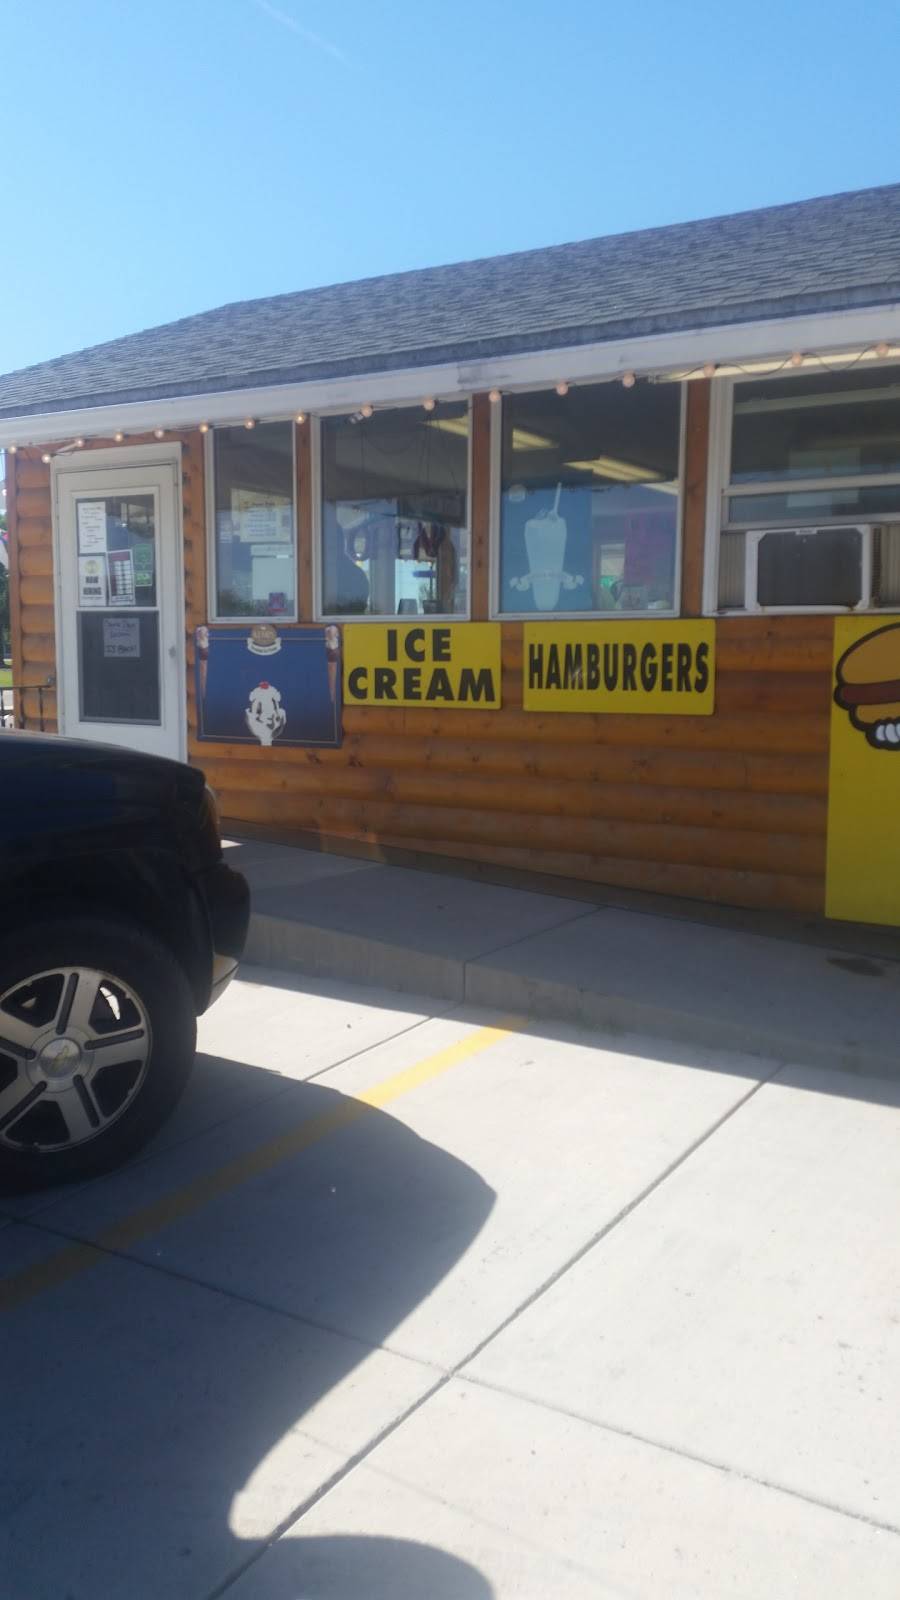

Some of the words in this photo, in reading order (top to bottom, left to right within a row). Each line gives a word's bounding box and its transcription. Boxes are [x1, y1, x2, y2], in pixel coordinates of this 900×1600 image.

[387, 628, 452, 662] ICE
[347, 667, 496, 702] CREAM
[528, 642, 709, 693] HAMBURGERS
